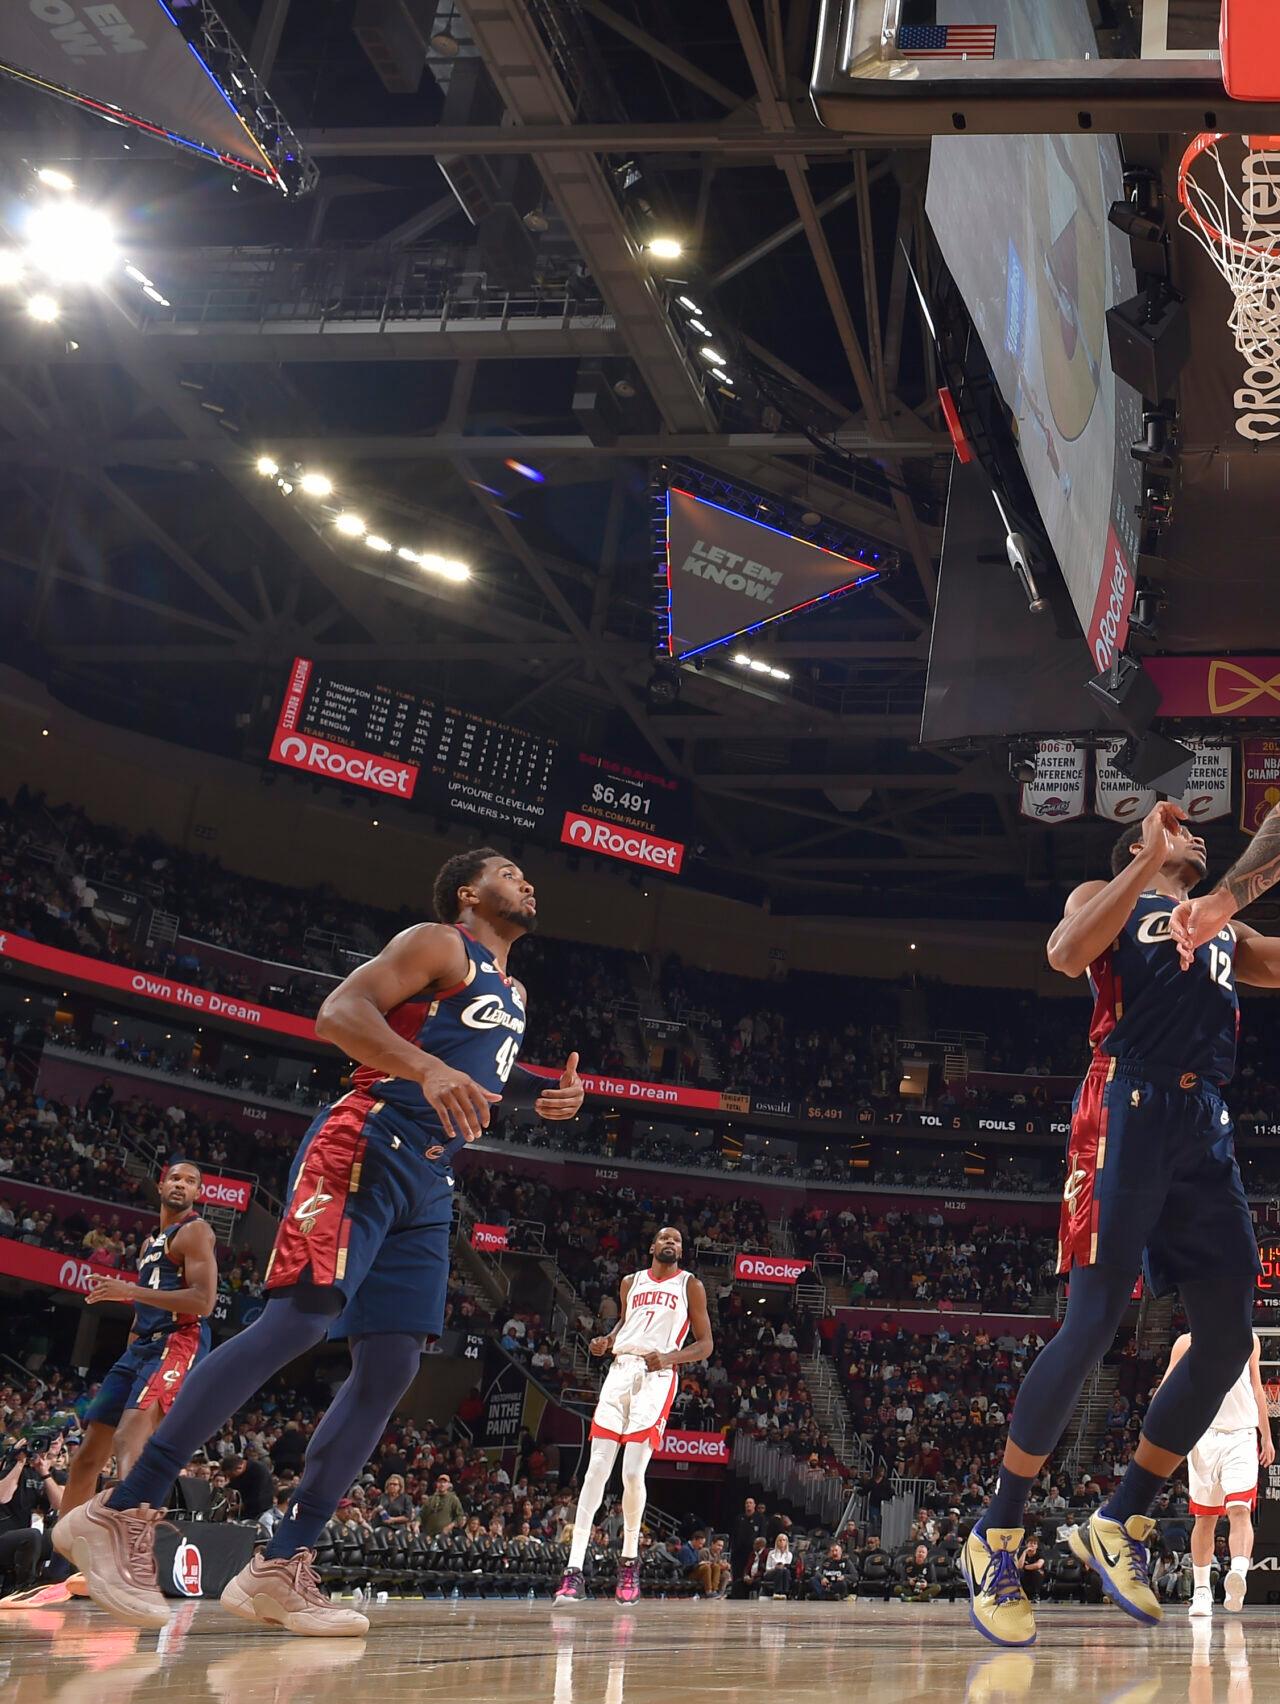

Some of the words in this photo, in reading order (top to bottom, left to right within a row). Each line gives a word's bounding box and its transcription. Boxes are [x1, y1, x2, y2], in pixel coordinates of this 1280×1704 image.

[692, 540, 743, 567] LET
[681, 556, 775, 604] KNOW.
[325, 690, 356, 704] DURANT
[328, 681, 370, 699] THOMPSON
[323, 699, 347, 711] SMITH
[320, 708, 346, 721] ADAMS
[318, 718, 350, 732] SENGUN
[308, 742, 409, 793] Rocket
[1028, 781, 1080, 792] CHAMPIONS
[494, 794, 545, 816] CLEVELAND
[589, 782, 652, 817] $6,491
[449, 797, 499, 818] CAVALIERS
[510, 815, 536, 829] YEAH
[593, 824, 676, 868] Rocket
[1208, 943, 1233, 992] 12
[132, 974, 171, 1000] Own
[176, 988, 204, 1007] the
[208, 995, 261, 1023] Dream
[495, 1036, 519, 1083] 45
[599, 1078, 625, 1094] the
[628, 1082, 678, 1102] Dream
[725, 1103, 742, 1112] TOTAL
[755, 1100, 791, 1114] oswald
[808, 1106, 843, 1120] $6,491
[919, 1114, 942, 1127] TOL
[951, 1115, 961, 1129] 5
[978, 1118, 1016, 1132] FOULS
[1025, 1121, 1034, 1134] 0
[944, 1201, 966, 1210] M126
[631, 1290, 678, 1311] ROCKETS
[214, 1307, 228, 1320] 34
[645, 1311, 655, 1332] 7
[467, 1334, 483, 1345] FG%
[464, 1346, 479, 1359] 44
[488, 1402, 499, 1418] IN
[501, 1401, 520, 1417] THE
[486, 1419, 518, 1436] PAINT
[664, 1436, 726, 1457] Rocket
[1268, 1464, 1280, 1476] GET
[1268, 1476, 1280, 1487] THE
